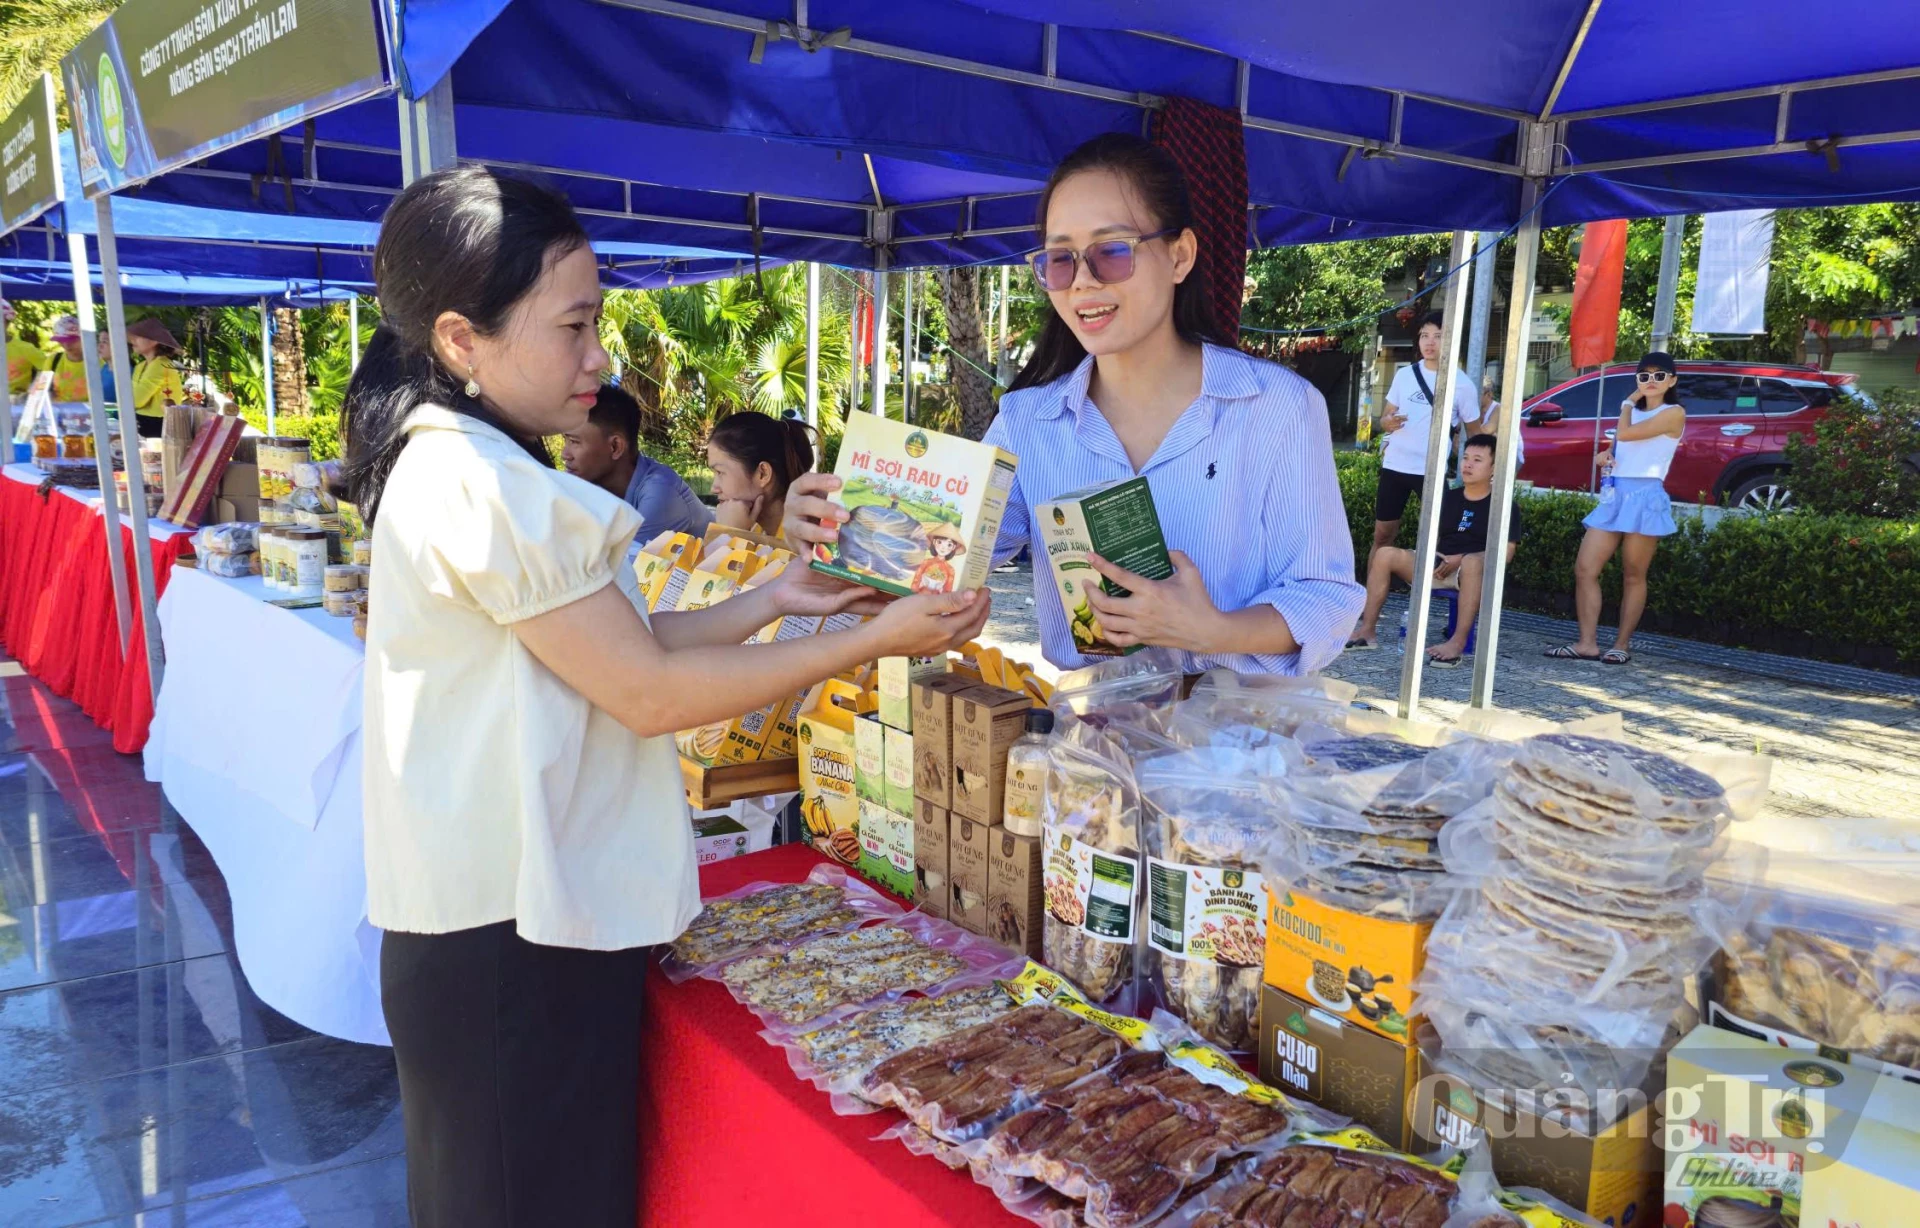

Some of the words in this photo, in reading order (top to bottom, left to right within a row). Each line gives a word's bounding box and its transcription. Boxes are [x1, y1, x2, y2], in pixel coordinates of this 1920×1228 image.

[140, 48, 161, 77] CÔNG
[160, 37, 171, 64] TY
[170, 20, 196, 56] TNHH
[169, 65, 194, 97] NÔNG
[214, 34, 240, 76] SẠCH
[271, 0, 298, 40] LAN
[851, 450, 872, 470] MÌ
[874, 458, 903, 480] SỢI
[906, 466, 942, 488] RAU
[945, 475, 969, 495] CỦ
[1069, 541, 1091, 553] XANH
[811, 755, 855, 784] BANANA
[813, 747, 831, 760] SOFT
[1191, 940, 1212, 949] 100%
[1282, 1060, 1309, 1092] mặn
[1689, 1118, 1718, 1146] MÌ
[1728, 1133, 1776, 1166] SỢI
